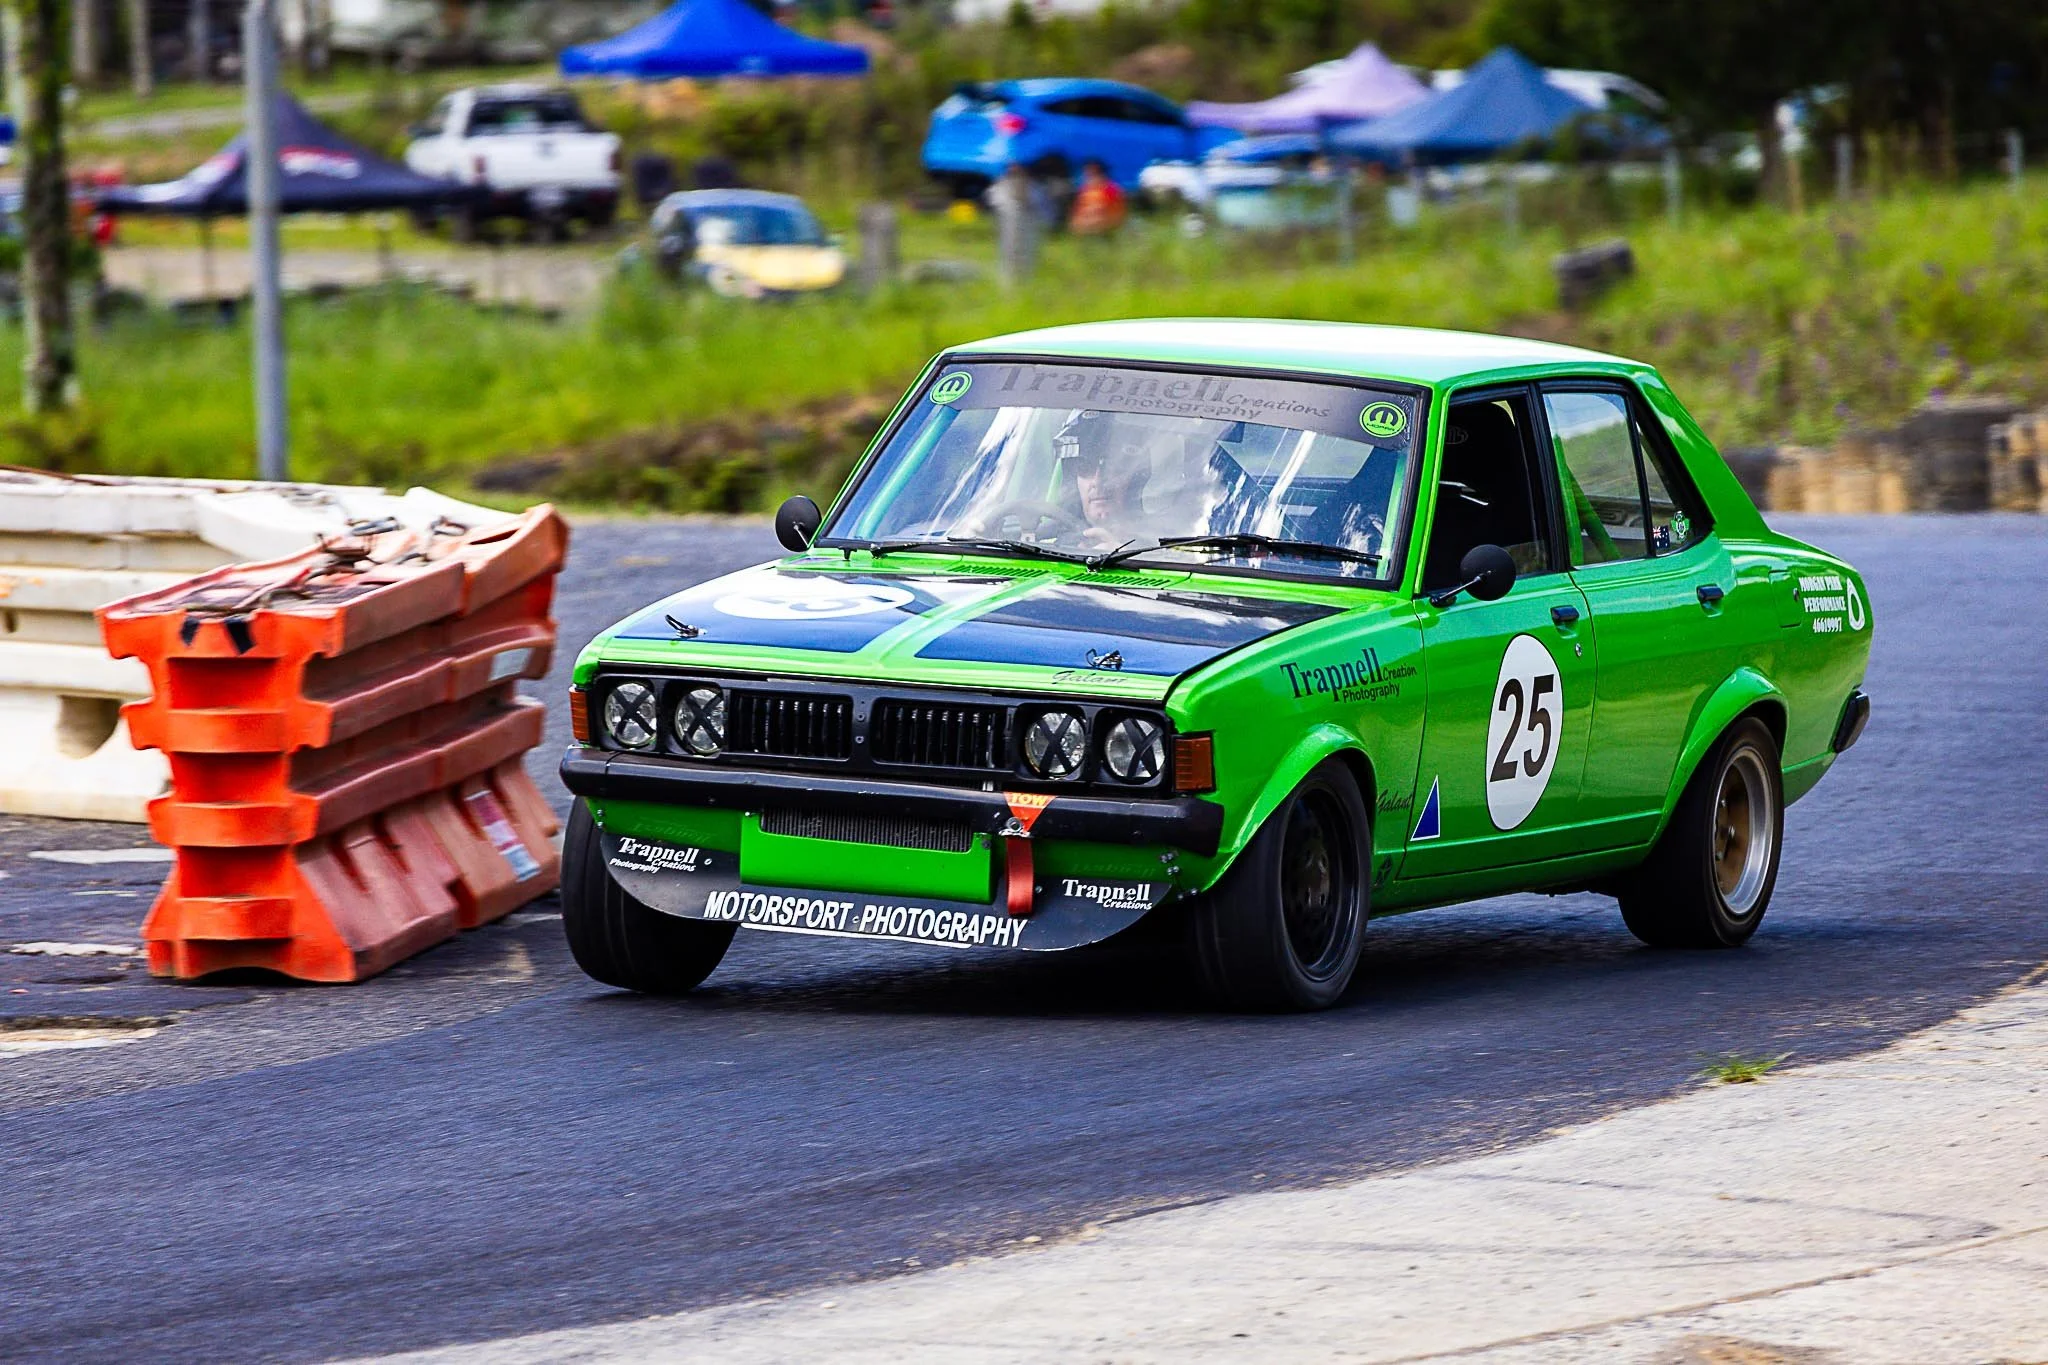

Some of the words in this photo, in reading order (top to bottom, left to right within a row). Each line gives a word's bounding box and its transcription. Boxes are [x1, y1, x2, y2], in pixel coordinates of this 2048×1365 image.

[999, 366, 1231, 402] Trapnell
[1226, 393, 1330, 418] Creations
[1108, 394, 1262, 420] Photography
[1803, 596, 1846, 612] PERFORMANCE
[1280, 648, 1382, 702] Trapnell
[1342, 682, 1400, 703] Photography
[1489, 673, 1555, 783] 25
[1009, 792, 1048, 805] TOW
[619, 836, 699, 864] Trapnell
[609, 858, 660, 873] Photography
[652, 859, 696, 872] Creations
[1062, 879, 1150, 904] Trapnell
[1103, 899, 1152, 910] Creations
[703, 891, 855, 931] MOTORSPORT
[859, 904, 1027, 947] PHOTOGRAPHY
